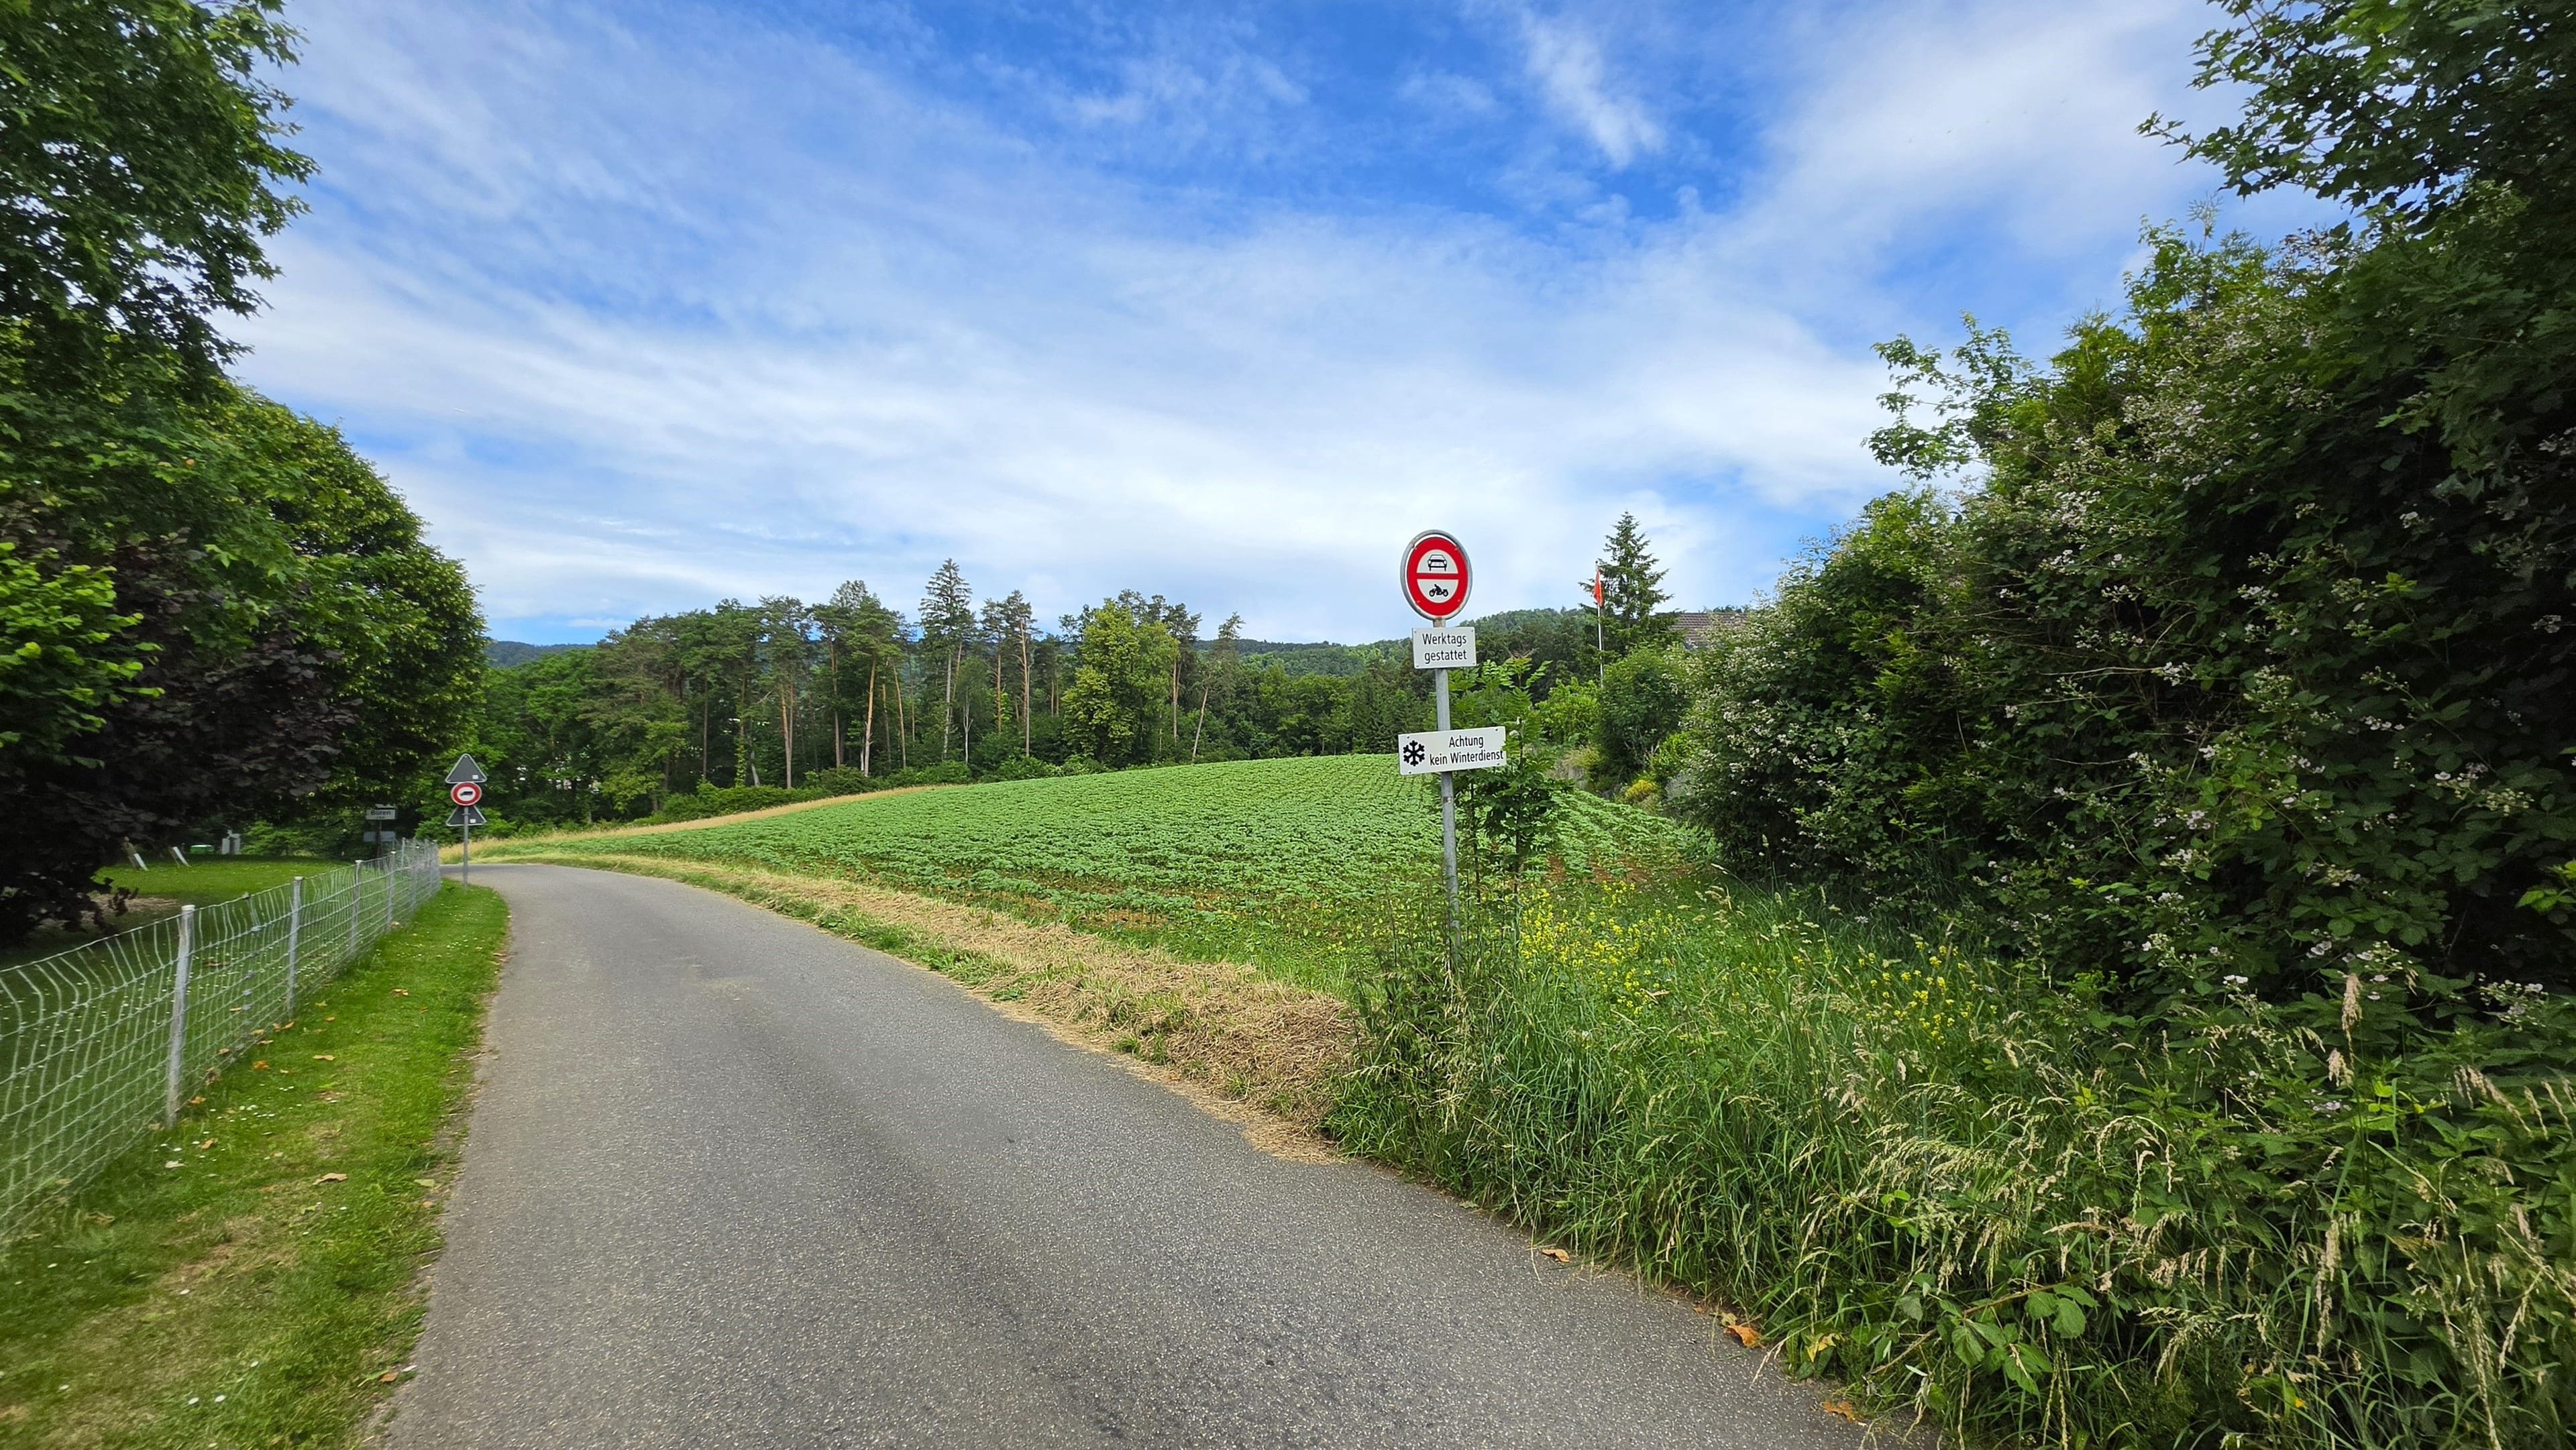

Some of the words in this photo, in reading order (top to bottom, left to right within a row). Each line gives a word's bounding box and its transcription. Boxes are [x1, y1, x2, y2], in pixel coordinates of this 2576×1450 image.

[1422, 632, 1467, 647] Werktags
[1424, 649, 1467, 665] gestattet
[1449, 735, 1484, 748] Achtung
[1430, 753, 1448, 766] kein
[1450, 750, 1504, 764] Winterdienst
